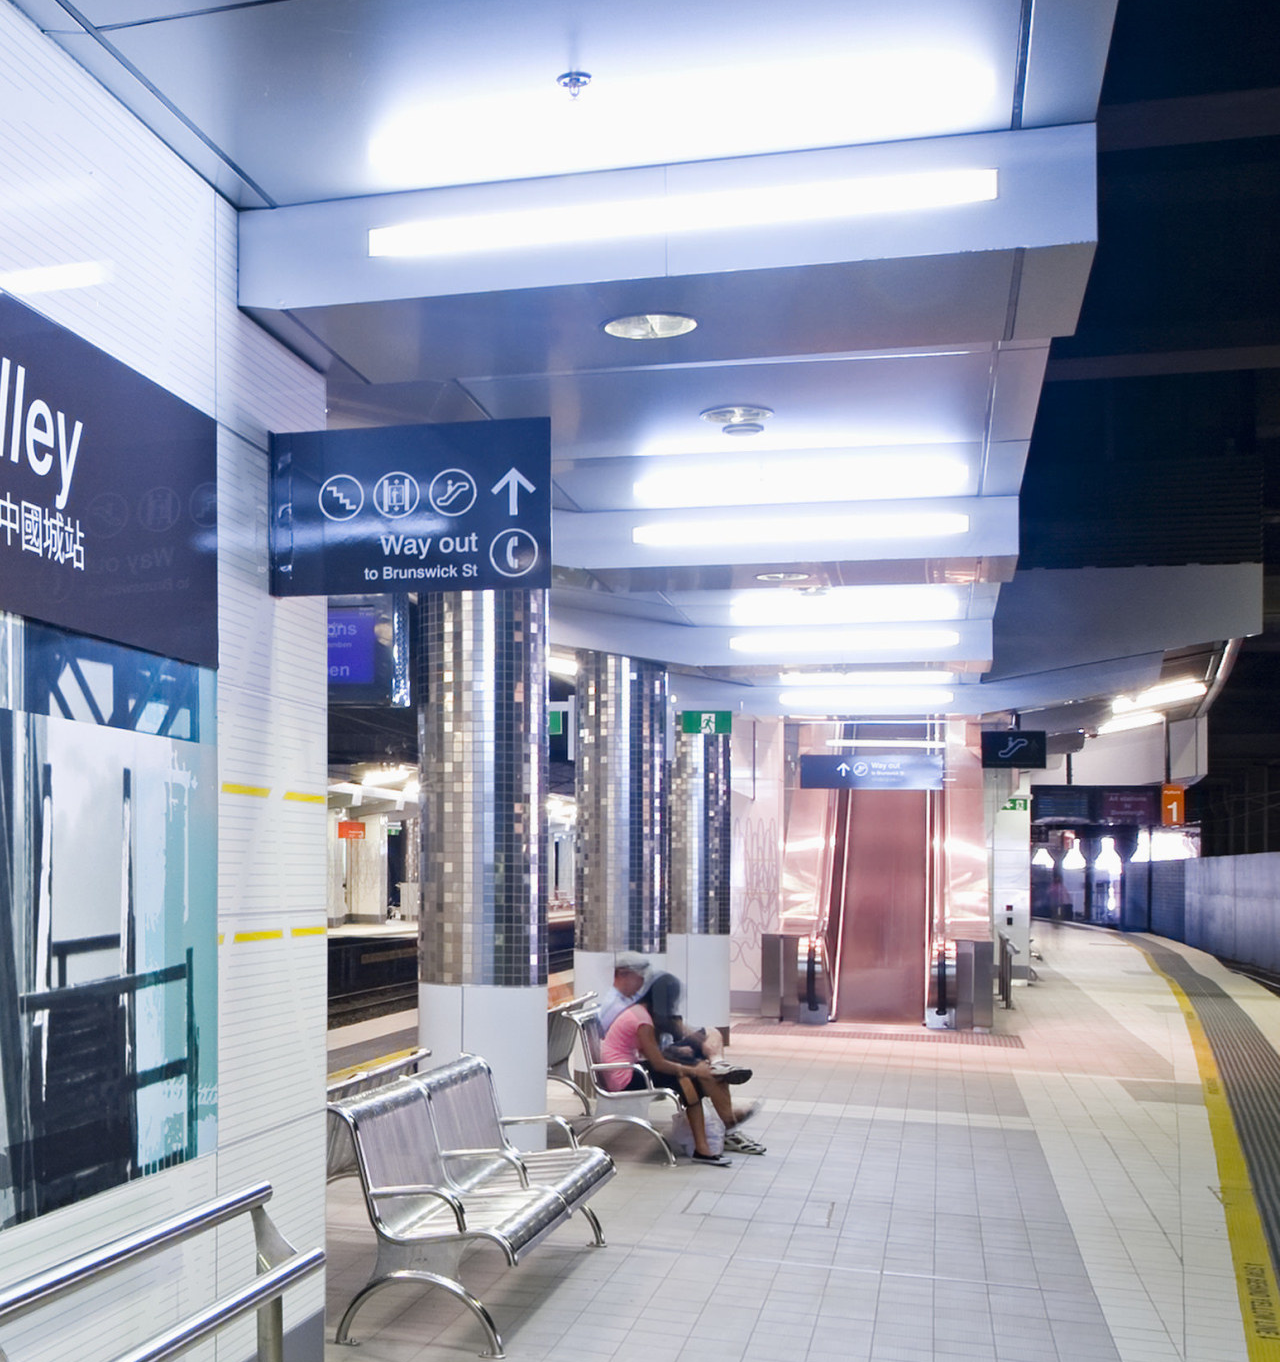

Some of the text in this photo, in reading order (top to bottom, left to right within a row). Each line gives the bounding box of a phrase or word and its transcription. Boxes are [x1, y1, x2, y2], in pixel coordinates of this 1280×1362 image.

[381, 532, 478, 559] Way out
[364, 563, 478, 581] to Brunswick St
[871, 762, 901, 771] Way out
[1167, 801, 1178, 823] 1
